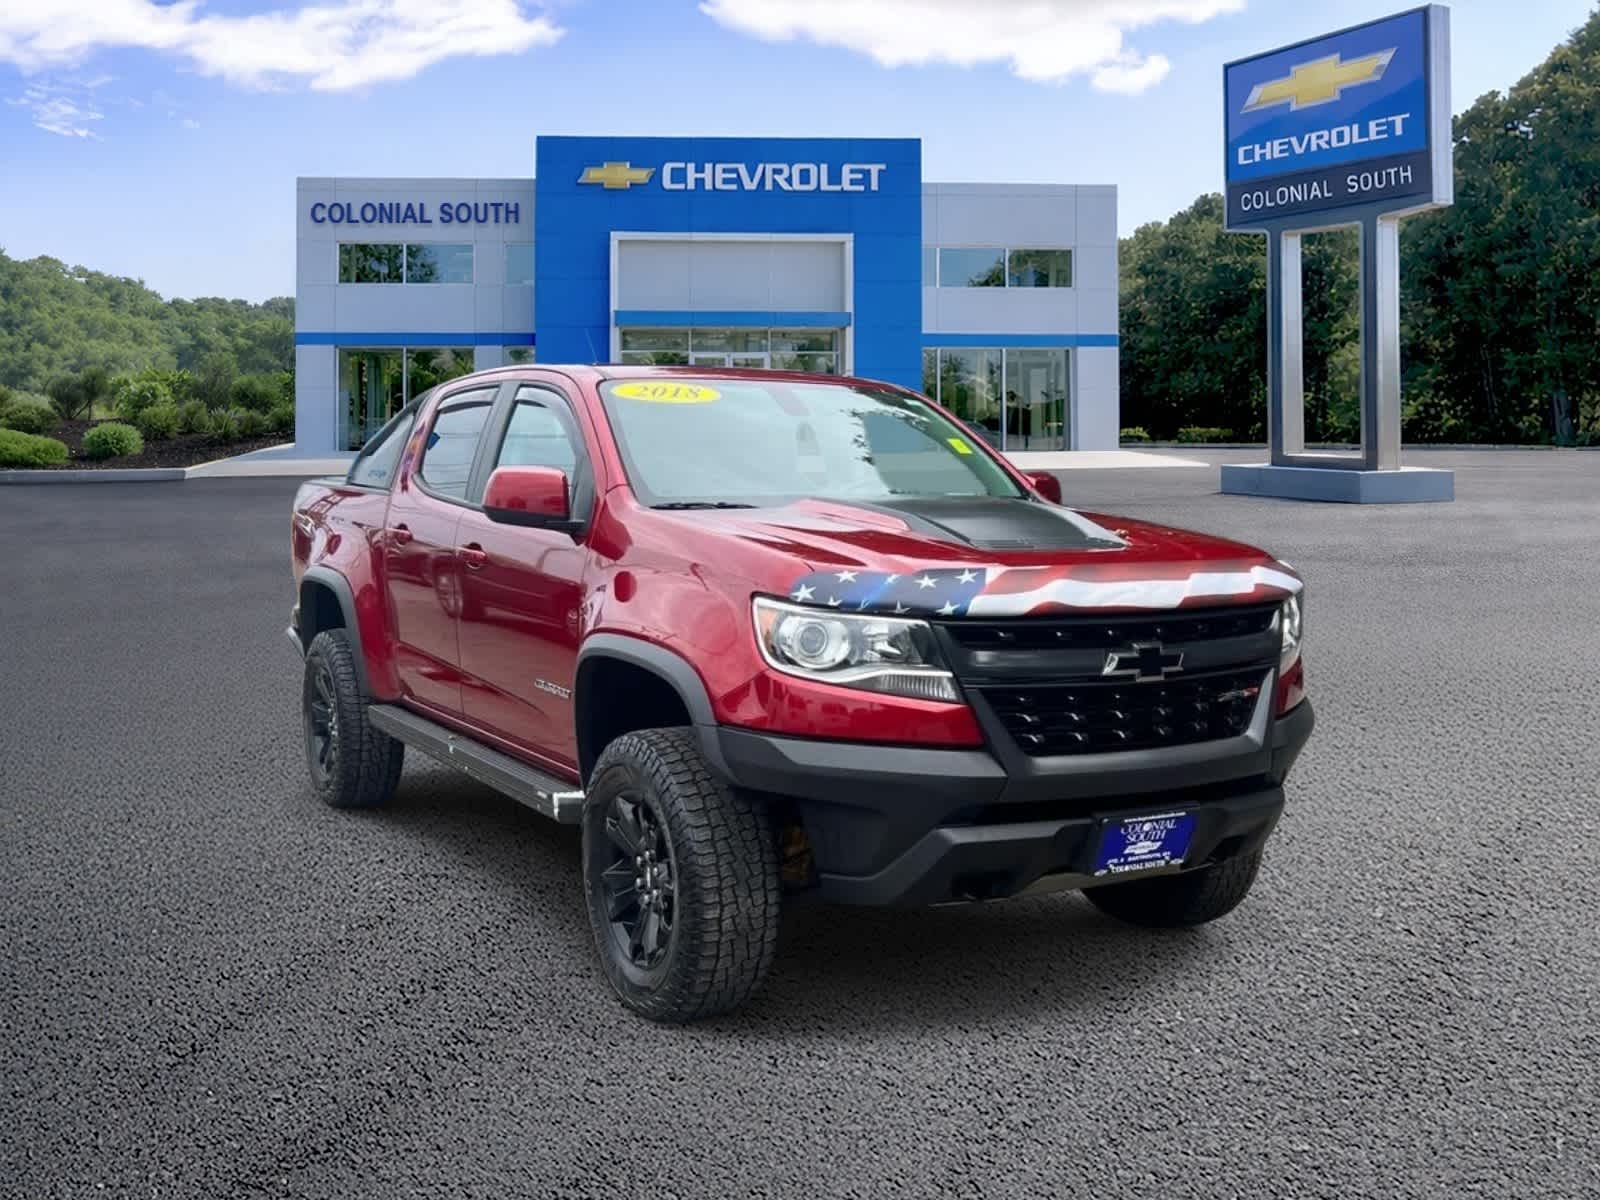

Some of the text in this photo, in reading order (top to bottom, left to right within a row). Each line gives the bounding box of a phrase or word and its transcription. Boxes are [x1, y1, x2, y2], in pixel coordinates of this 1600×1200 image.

[1237, 113, 1410, 165] CHEVROLET
[662, 162, 887, 191] CHEVROLET
[1240, 165, 1412, 211] COLONIAL SOUTH
[310, 202, 520, 224] COLONIAL SOUTH
[637, 385, 701, 400] 2018
